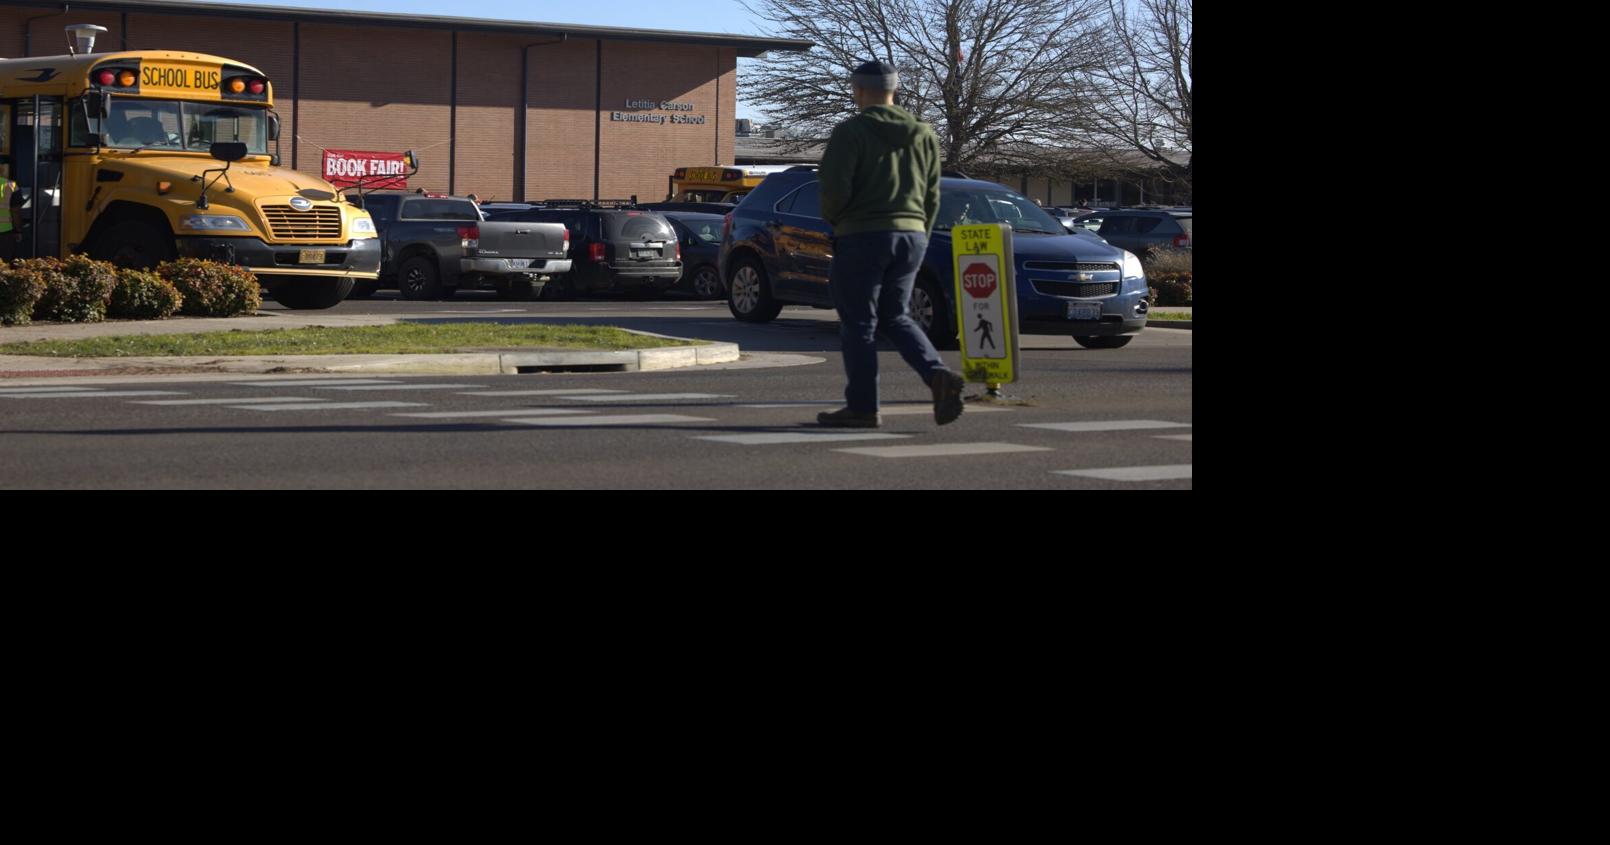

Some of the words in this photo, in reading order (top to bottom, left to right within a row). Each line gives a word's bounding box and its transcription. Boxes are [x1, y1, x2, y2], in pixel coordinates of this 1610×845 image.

[143, 66, 190, 87] SCHOOL
[194, 70, 218, 90] BUS
[625, 98, 656, 109] Letitia
[659, 100, 694, 111] Carson
[611, 111, 666, 125] Elementary
[671, 114, 704, 124] School
[326, 157, 366, 177] BOOK
[370, 159, 404, 178] FAIR!
[960, 229, 992, 239] STATE
[965, 241, 988, 251] LAW
[964, 273, 994, 288] STOP
[973, 302, 990, 310] FOR
